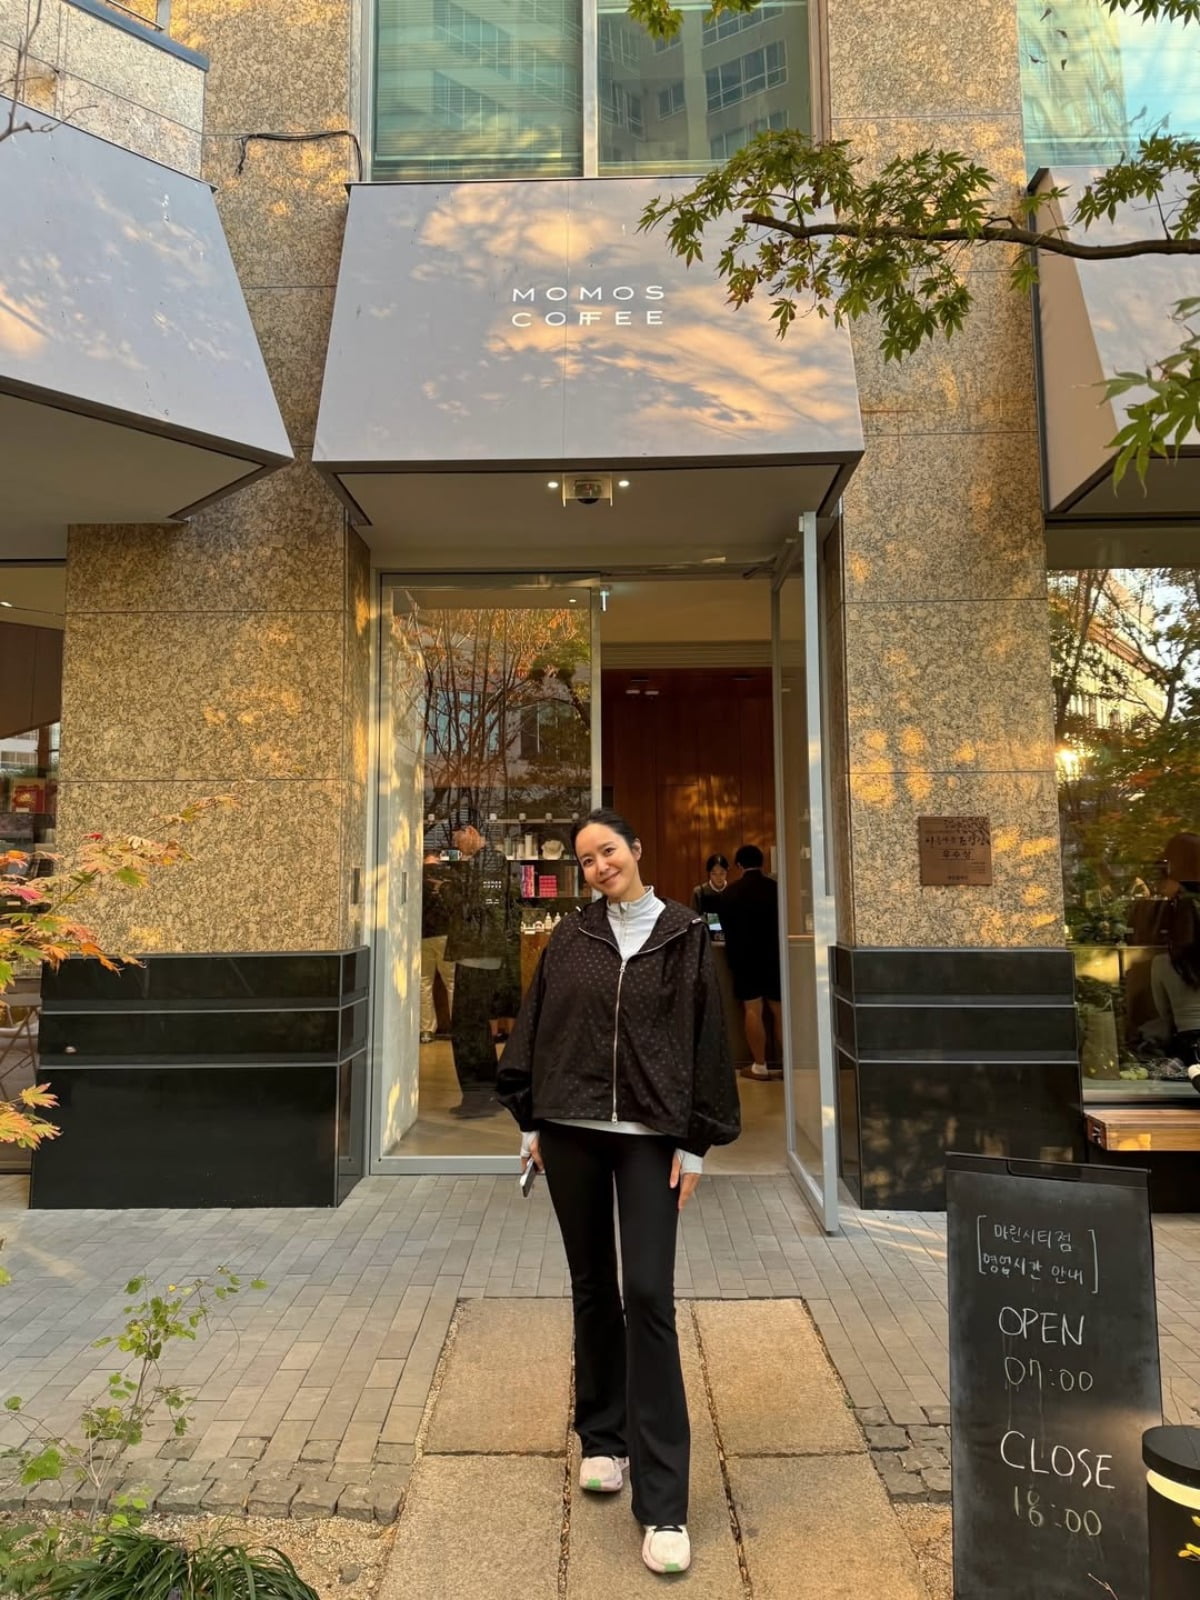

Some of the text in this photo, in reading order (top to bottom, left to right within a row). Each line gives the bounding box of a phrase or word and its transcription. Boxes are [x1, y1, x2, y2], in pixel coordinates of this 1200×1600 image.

[512, 285, 665, 302] MOMOS
[511, 310, 664, 328] COFFEE
[983, 1252, 1084, 1285] 영업시간 안내
[998, 1306, 1085, 1347] OPEN
[1004, 1356, 1094, 1392] 07:00
[1000, 1430, 1116, 1490] CLOSE
[1014, 1485, 1103, 1537] 18:00
